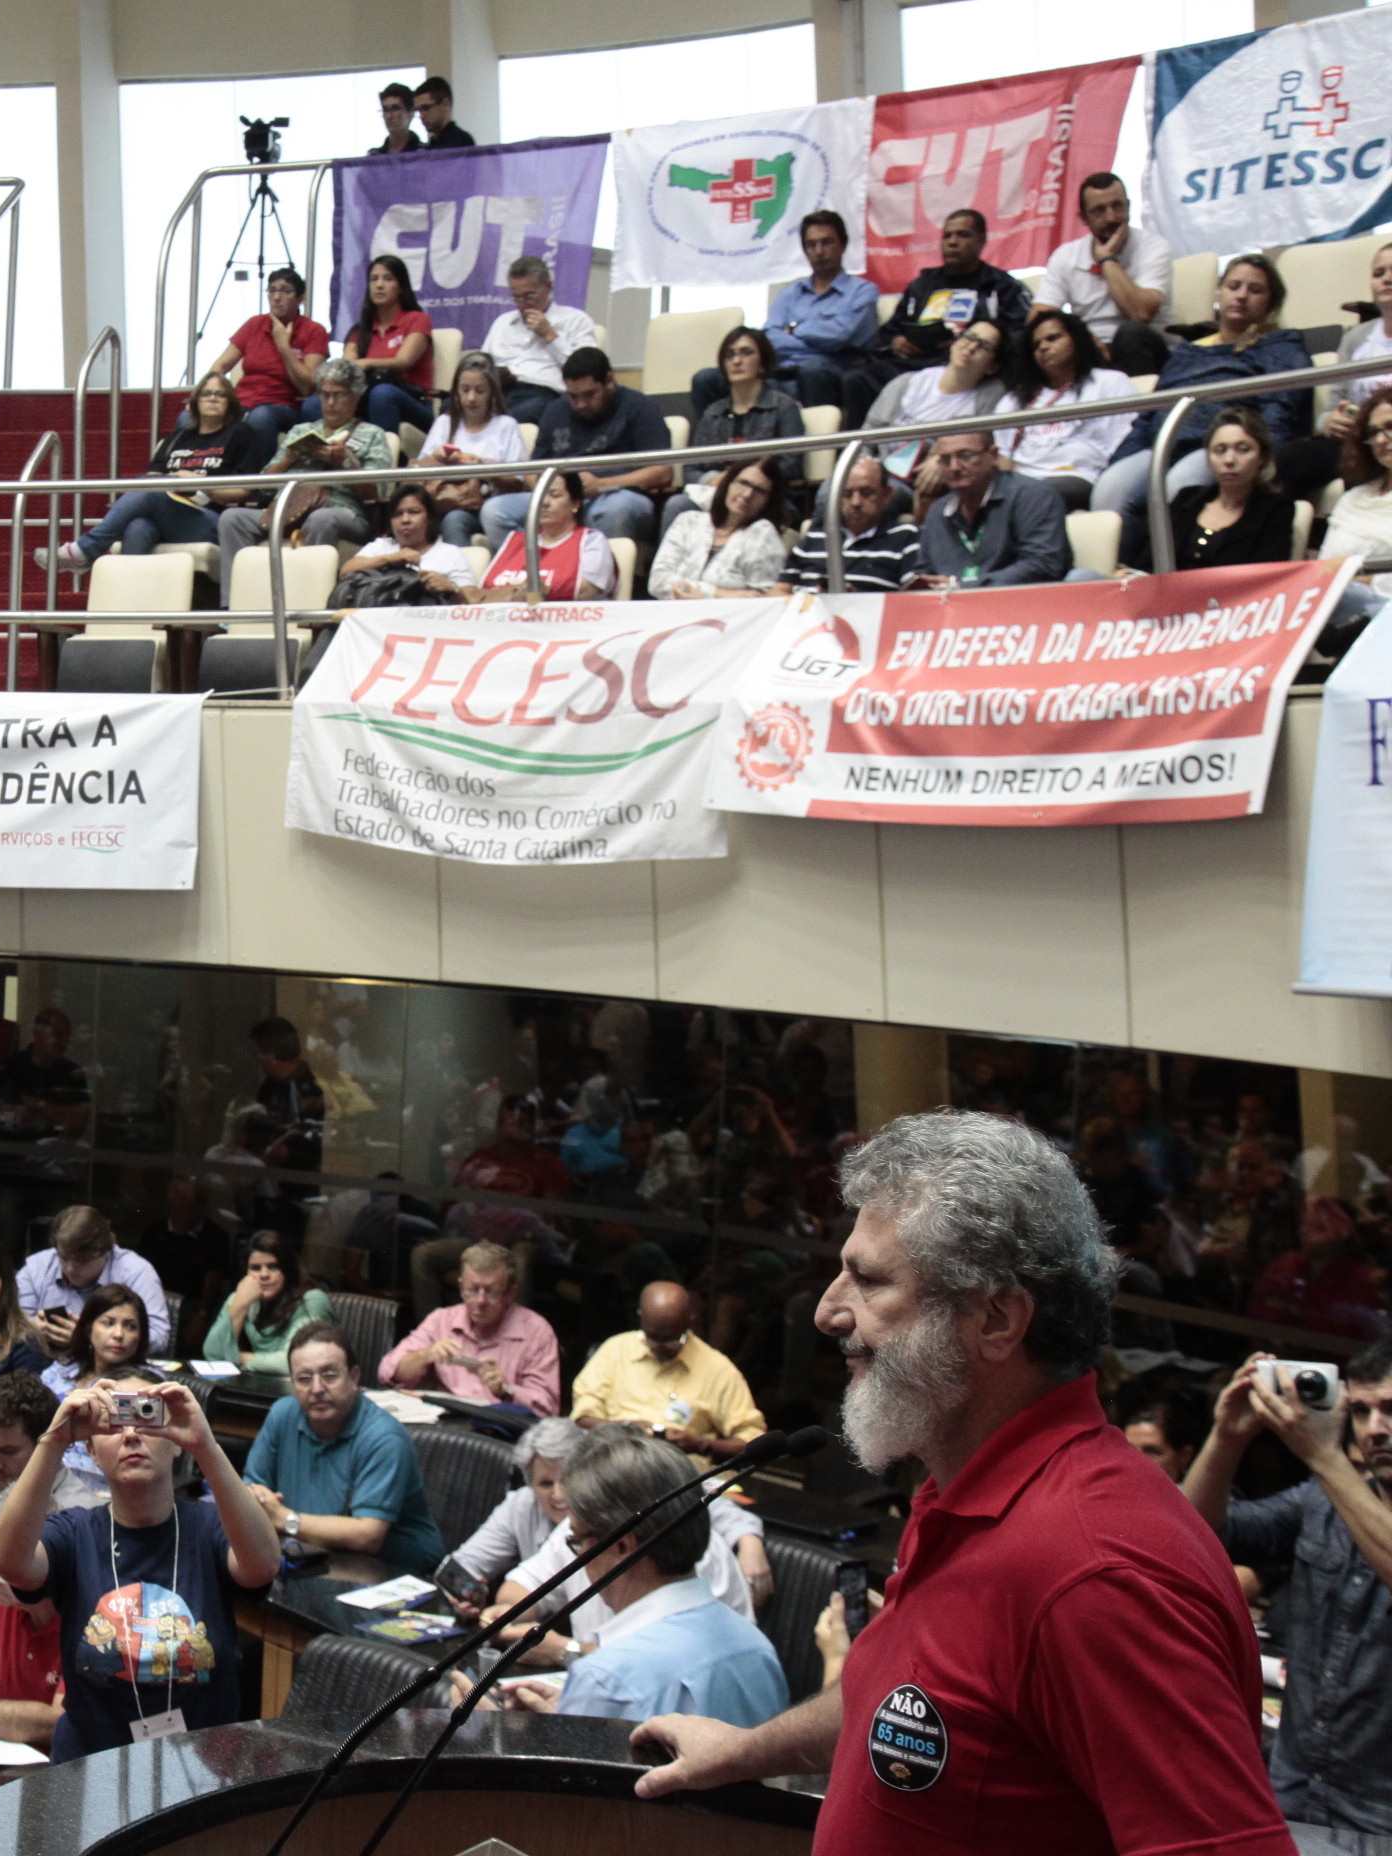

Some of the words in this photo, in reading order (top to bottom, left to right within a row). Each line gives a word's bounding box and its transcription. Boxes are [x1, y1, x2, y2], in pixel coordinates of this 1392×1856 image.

[867, 107, 1052, 237] CUT
[1038, 93, 1080, 213] BRASIL
[1181, 138, 1387, 204] SITESSC
[371, 195, 543, 291] CUT
[450, 606, 486, 621] CUT
[508, 606, 604, 622] CONTRACS
[886, 630, 935, 671] EM
[928, 624, 1039, 669] DEFESA
[1037, 622, 1085, 665] DA
[1082, 592, 1288, 662] PREVIDÊNCIA
[1286, 587, 1321, 631] E
[351, 618, 726, 727] FECESC
[780, 651, 858, 679] UGT
[843, 687, 906, 727] DOS
[902, 687, 1038, 727] DIREITOS
[1035, 664, 1269, 723] TRABALHISTAS
[92, 714, 117, 747] A
[343, 748, 449, 793] Federação
[456, 770, 496, 798] dos
[844, 765, 963, 794] NENHUM
[970, 766, 1083, 795] DIREITO
[1086, 766, 1107, 790] A
[1114, 751, 1237, 789] MENOS!
[338, 777, 490, 829] Trabalhadores
[498, 808, 526, 831] no
[535, 800, 643, 831] Comércio
[651, 799, 676, 821] no
[57, 836, 65, 845] e
[71, 830, 125, 848] FECESC
[334, 808, 405, 844] Estado
[412, 824, 435, 850] de
[444, 830, 507, 861] Santa
[514, 835, 608, 862] Catarina
[109, 1597, 139, 1616] 47%
[149, 1600, 179, 1618] 53%
[885, 1712, 924, 1731] aposentadoria
[924, 1725, 939, 1735] aos
[890, 1692, 927, 1719] NÃO
[877, 1722, 894, 1742] 65
[895, 1732, 936, 1755] anos
